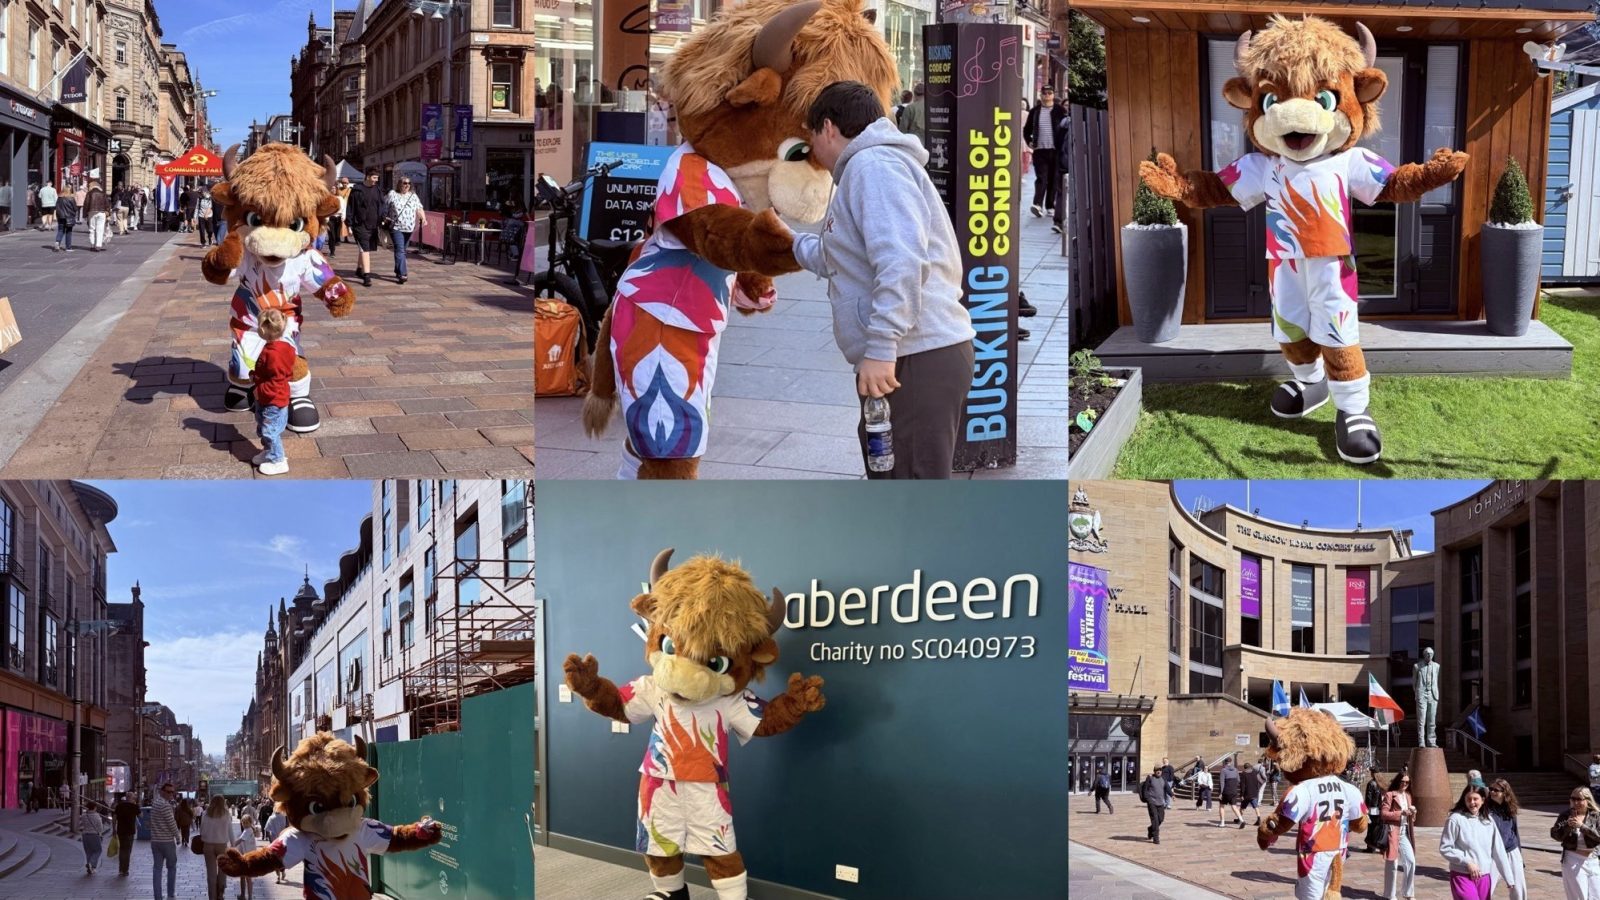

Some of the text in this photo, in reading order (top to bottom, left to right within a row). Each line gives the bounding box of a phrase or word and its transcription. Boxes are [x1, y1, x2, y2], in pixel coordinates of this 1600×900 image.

[928, 45, 952, 60] BUSKING
[928, 63, 952, 73] CODE OF
[928, 75, 952, 84] CONDUCT
[992, 107, 1012, 256] CONDUCT
[606, 183, 658, 196] UNLIMITED
[968, 129, 990, 257] CODE OF
[605, 199, 633, 210] DATA
[966, 265, 1010, 442] BUSKING
[1468, 485, 1502, 520] JOHN
[1236, 524, 1377, 553] THE GLASGOW ROYAL CONCERT HALL
[783, 569, 1039, 629] aberdeen
[1115, 603, 1148, 616] HALL
[1085, 595, 1095, 649] GATHERS
[810, 635, 1036, 665] Charity no SC040973
[1068, 671, 1105, 683] festival
[1318, 782, 1342, 794] DON
[1318, 799, 1344, 822] 25
[442, 823, 458, 832] ESIGNED
[441, 832, 459, 841] OUTIQUE
